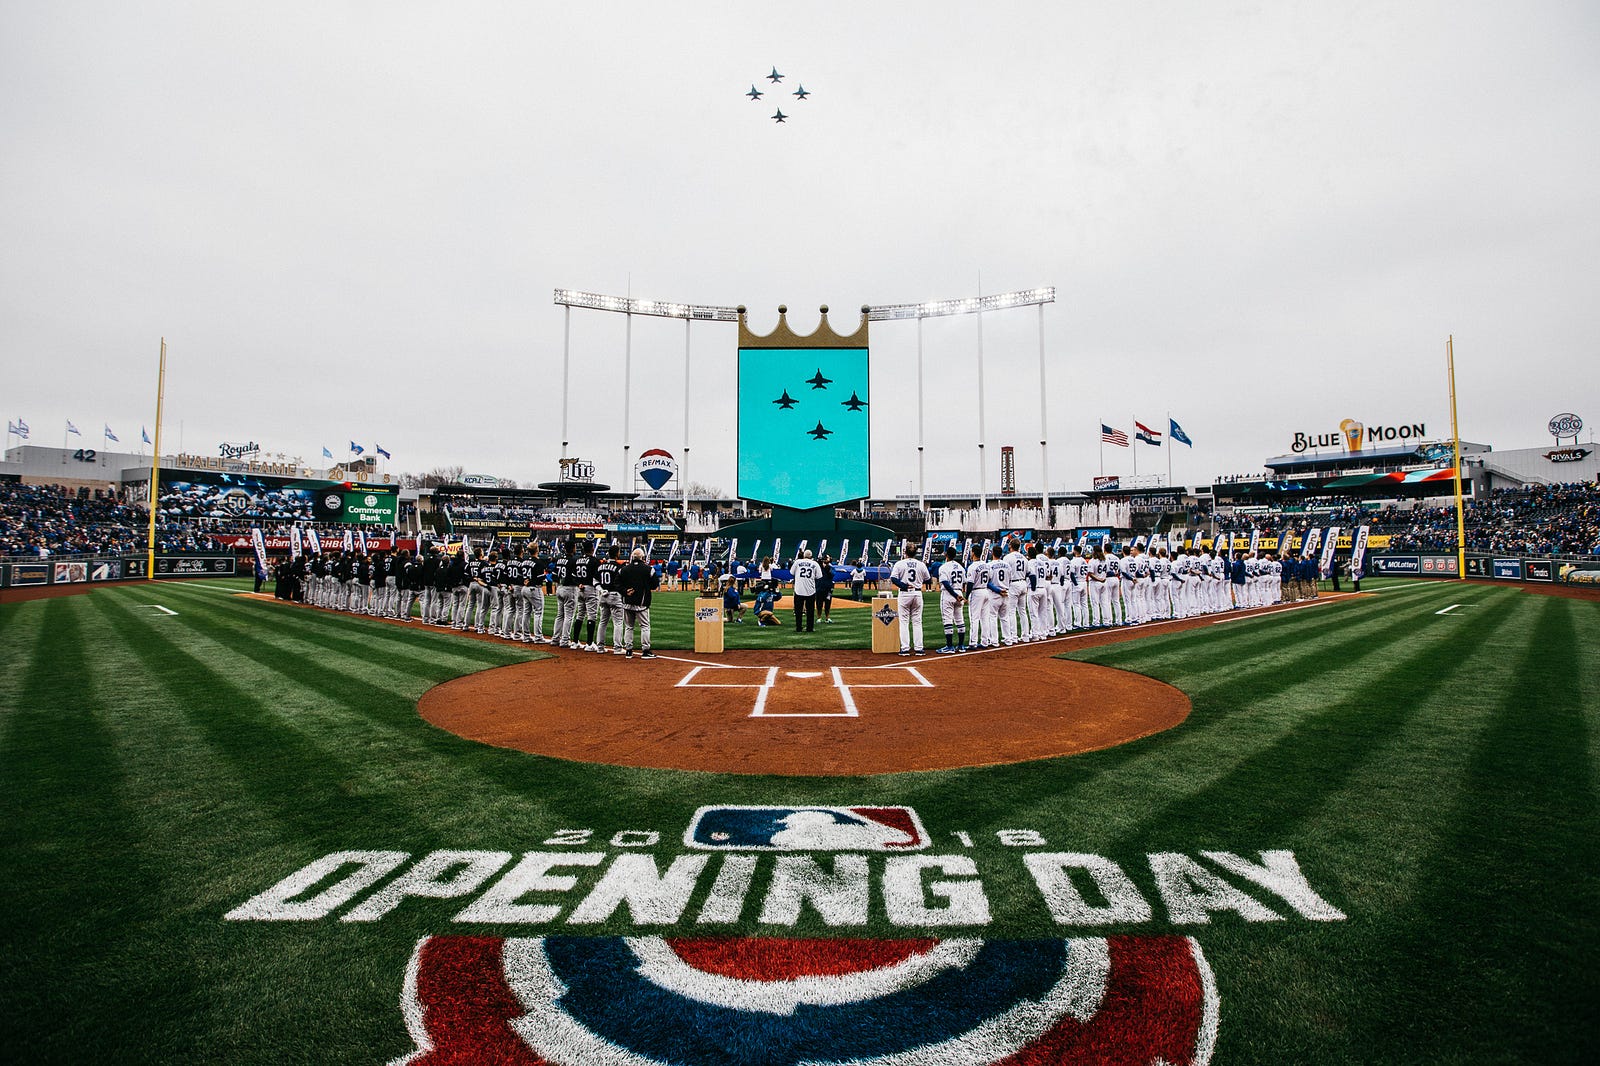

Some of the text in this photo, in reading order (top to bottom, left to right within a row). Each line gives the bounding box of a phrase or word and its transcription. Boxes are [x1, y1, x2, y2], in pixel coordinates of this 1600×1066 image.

[1550, 418, 1581, 435] 360
[1292, 424, 1425, 452] BLUE MOON
[74, 449, 96, 462] 42
[219, 442, 260, 458] Royals
[1551, 452, 1582, 460] RIVALS
[176, 454, 228, 472] HALL
[248, 460, 296, 476] FAME
[642, 459, 671, 468] RE/MAX
[328, 469, 344, 480] 20
[356, 471, 368, 482] 10
[566, 462, 595, 481] Lite
[383, 474, 391, 484] 5
[228, 497, 246, 509] 50
[1131, 496, 1176, 506] CHOPPER
[348, 506, 392, 514] Commerce
[1322, 532, 1336, 566] 2017
[1353, 531, 1366, 567] 2018
[1016, 560, 1024, 571] 21
[1080, 566, 1088, 575] 65
[1098, 565, 1107, 574] 64
[1110, 562, 1118, 570] 56
[1129, 563, 1136, 572] 55
[1388, 561, 1417, 570] MOLottery
[471, 568, 479, 576] 15
[497, 568, 500, 580] 7
[508, 567, 518, 578] 30
[522, 568, 532, 579] 24
[556, 566, 566, 578] 79
[576, 566, 587, 577] 26
[800, 568, 812, 578] 23
[908, 569, 916, 582] 3
[951, 571, 962, 583] 25
[998, 570, 1004, 581] 8
[1038, 567, 1044, 578] 19
[485, 573, 491, 583] 5
[601, 572, 611, 584] 10
[980, 571, 988, 584] 15
[544, 828, 1046, 848] 20 18
[222, 848, 1348, 926] OPENING DAY
